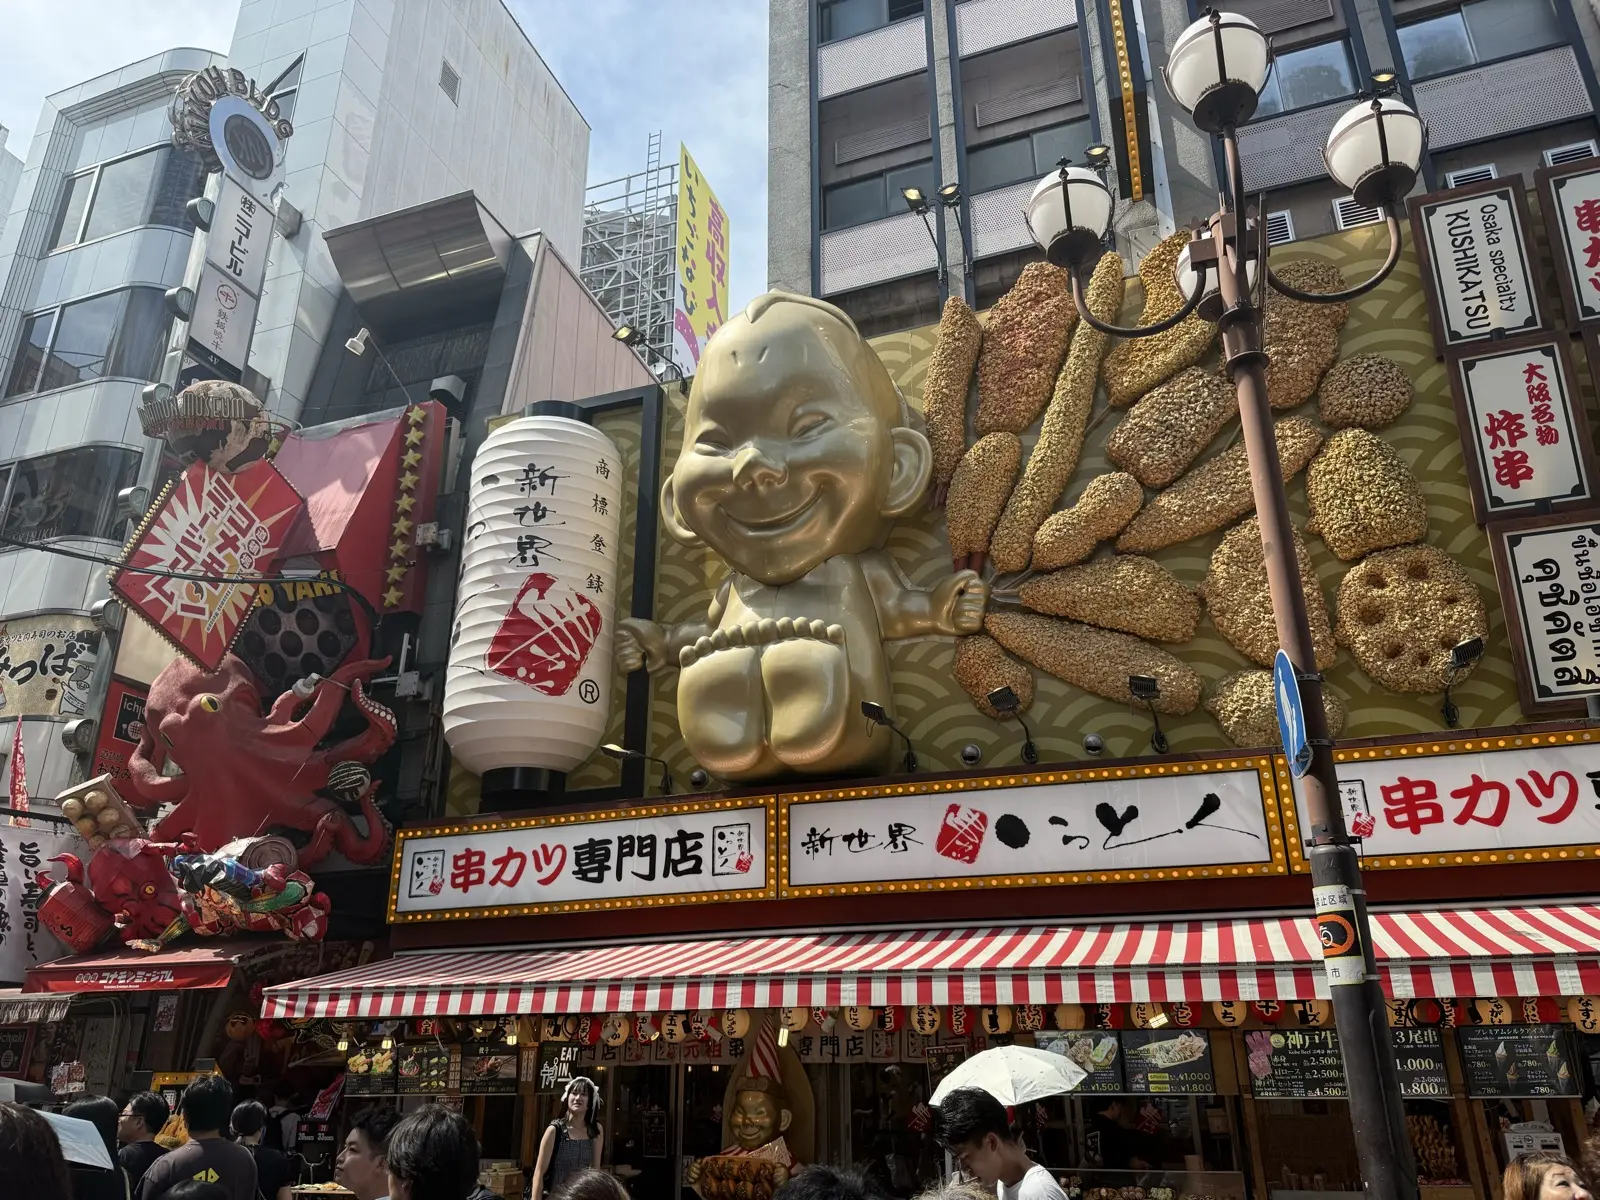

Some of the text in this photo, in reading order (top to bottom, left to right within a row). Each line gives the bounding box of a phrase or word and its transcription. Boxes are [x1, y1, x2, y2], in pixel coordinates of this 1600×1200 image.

[1445, 209, 1491, 330] KUSHIKATSU
[1480, 204, 1516, 312] Osaka specialty
[208, 354, 219, 364] 4F
[180, 391, 245, 419] MUSEUM
[1523, 363, 1559, 446] 大阪名物
[1484, 410, 1533, 489] 炸串
[509, 463, 570, 568] 新世界
[586, 459, 610, 593] 商標登録
[1380, 770, 1600, 835] 串カツ
[800, 822, 924, 861] 新世界
[451, 829, 704, 894] 串カツ専門店
[666, 1015, 677, 1039] 玉子
[692, 1016, 704, 1037] 山芋
[954, 1005, 964, 1034] ングコーン
[1578, 998, 1597, 1029] なすび
[560, 1047, 578, 1061] EAT
[799, 1035, 863, 1058] 専門店
[558, 1062, 568, 1076] IN
